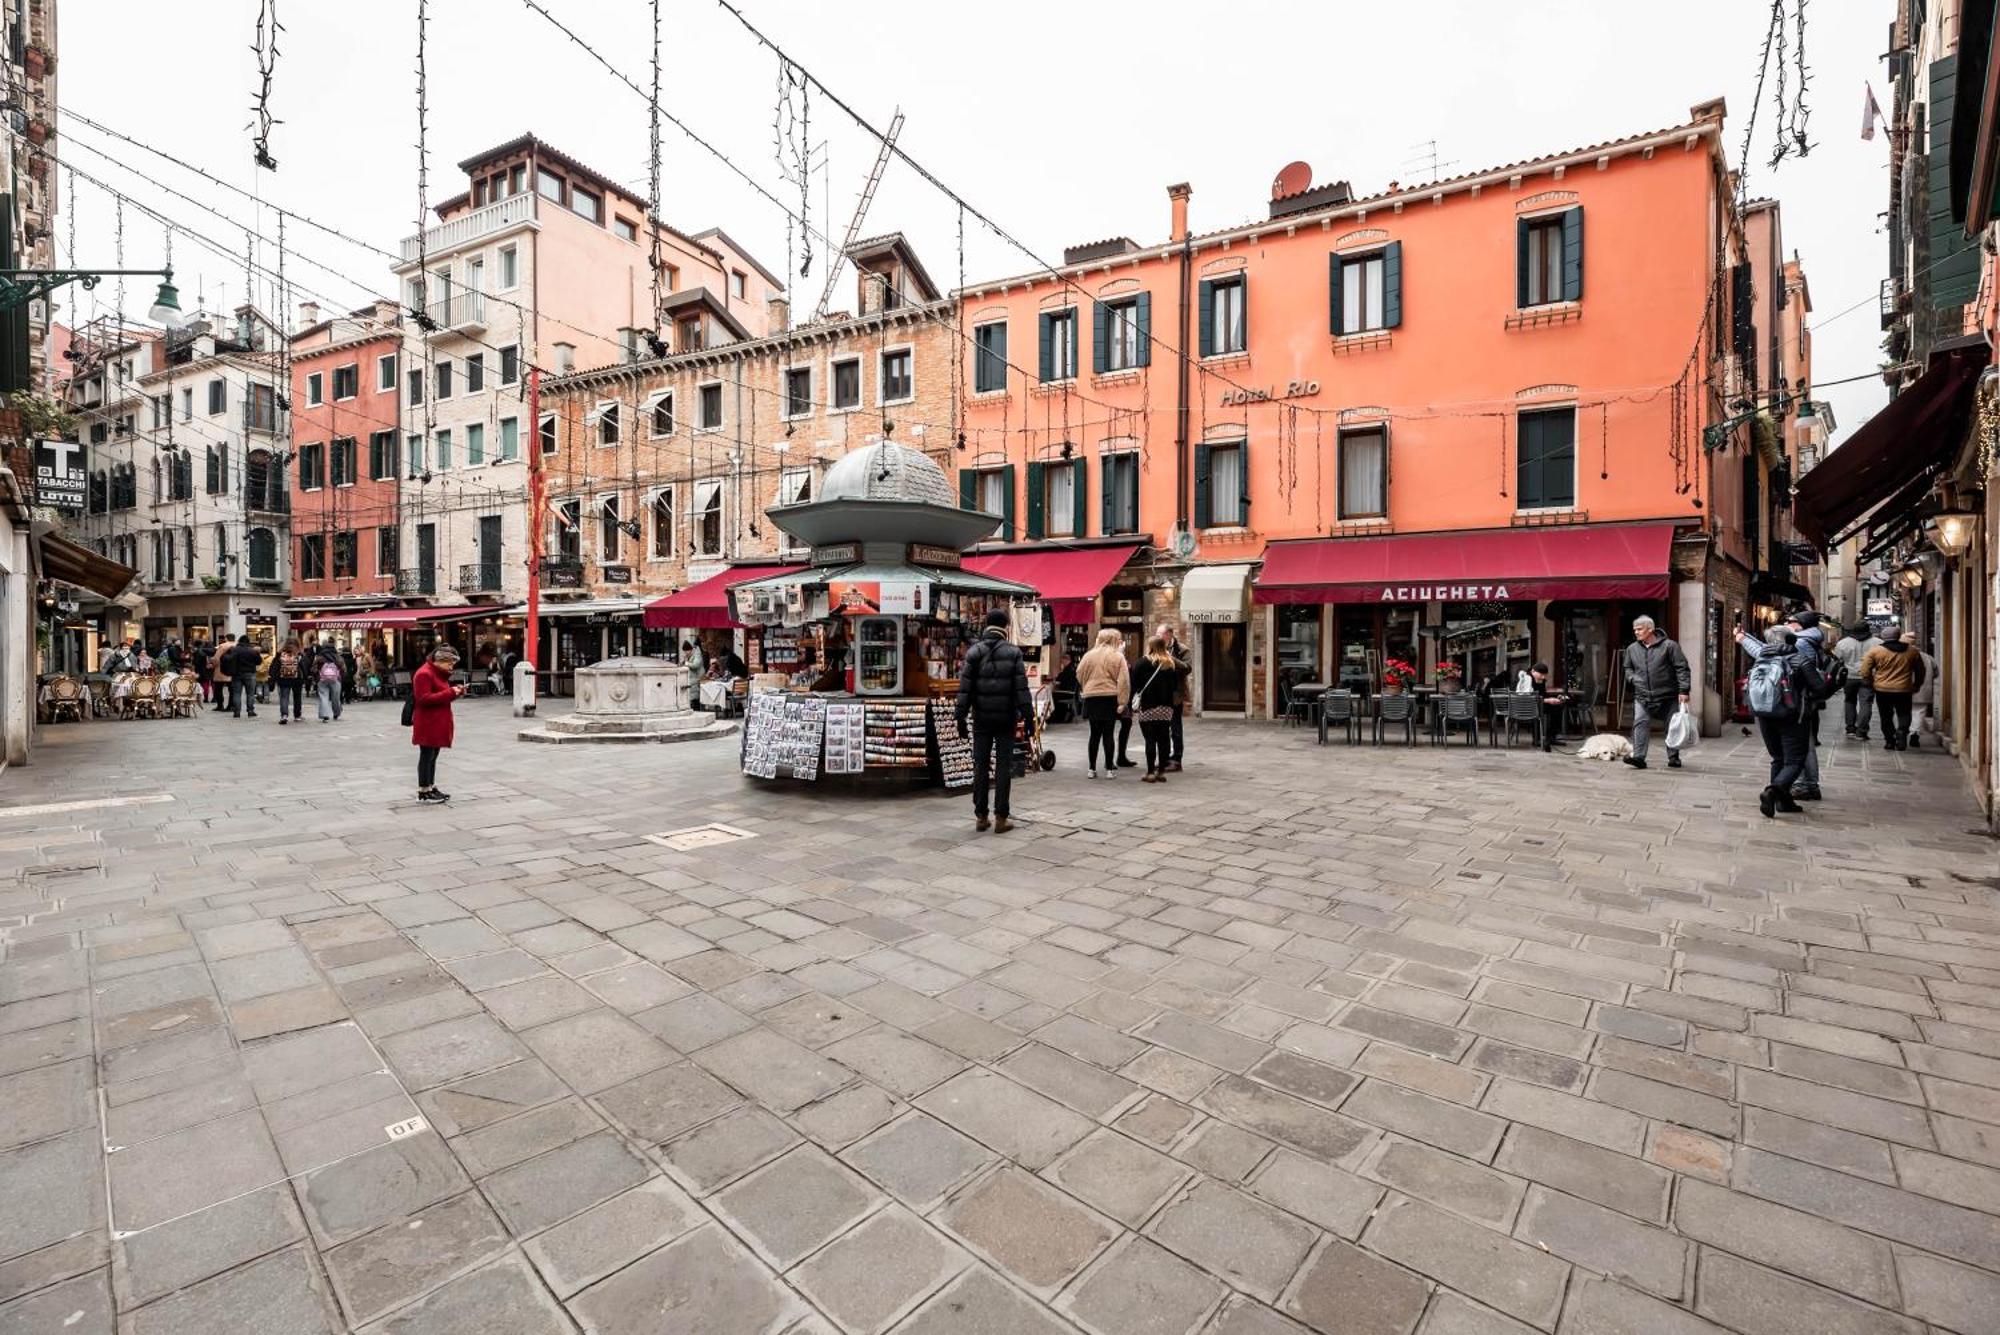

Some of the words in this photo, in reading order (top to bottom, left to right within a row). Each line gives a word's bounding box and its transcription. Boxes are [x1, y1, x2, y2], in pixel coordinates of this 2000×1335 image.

[42, 441, 79, 479] T
[37, 477, 86, 489] TABACCHI
[40, 491, 83, 502] LOTTO
[1381, 585, 1509, 600] ACIUGHETA
[1188, 612, 1213, 621] hotel
[1218, 613, 1232, 621] rio
[392, 1119, 417, 1135] OF
